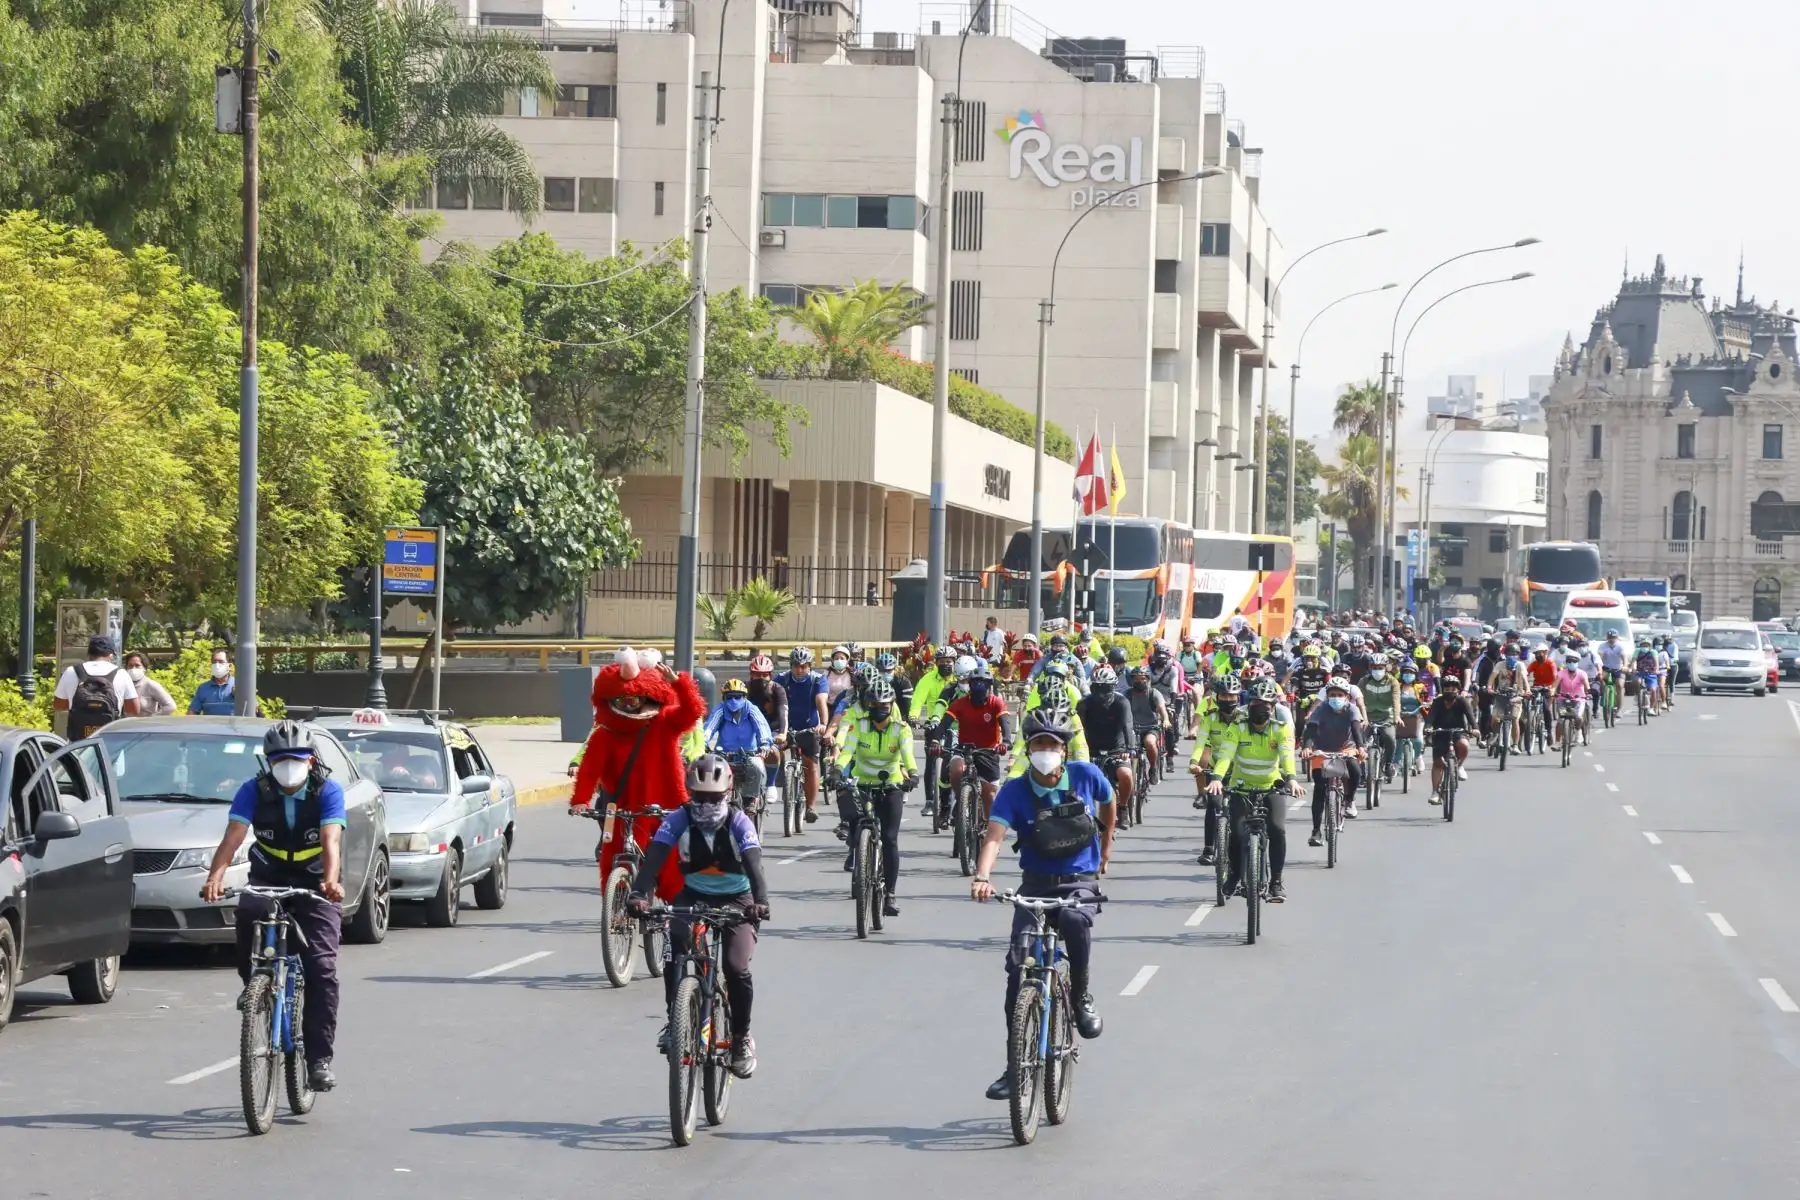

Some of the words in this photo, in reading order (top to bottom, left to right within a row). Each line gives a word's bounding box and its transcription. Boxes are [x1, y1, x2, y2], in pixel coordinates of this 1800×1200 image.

[1009, 126, 1143, 188] Real
[1070, 186, 1141, 211] plaza
[354, 713, 381, 724] TAXI
